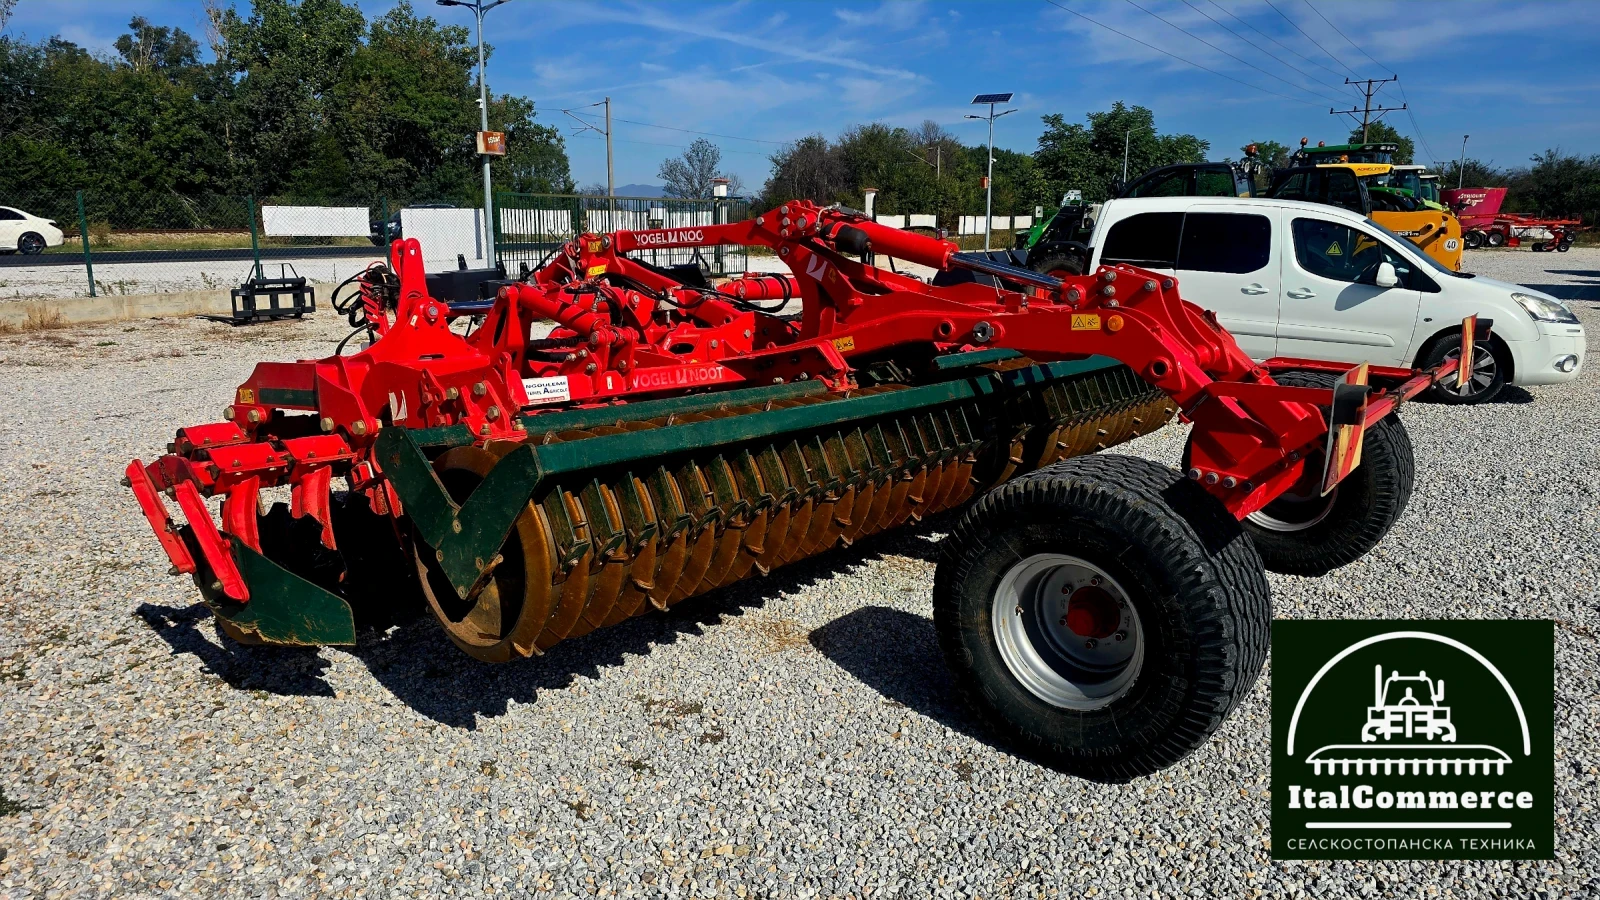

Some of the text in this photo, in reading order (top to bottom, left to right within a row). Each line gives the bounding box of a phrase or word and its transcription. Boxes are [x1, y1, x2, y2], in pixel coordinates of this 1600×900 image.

[1446, 240, 1456, 249] 40
[632, 367, 723, 389] VOGEL NOOT
[525, 381, 567, 389] NGOULEME
